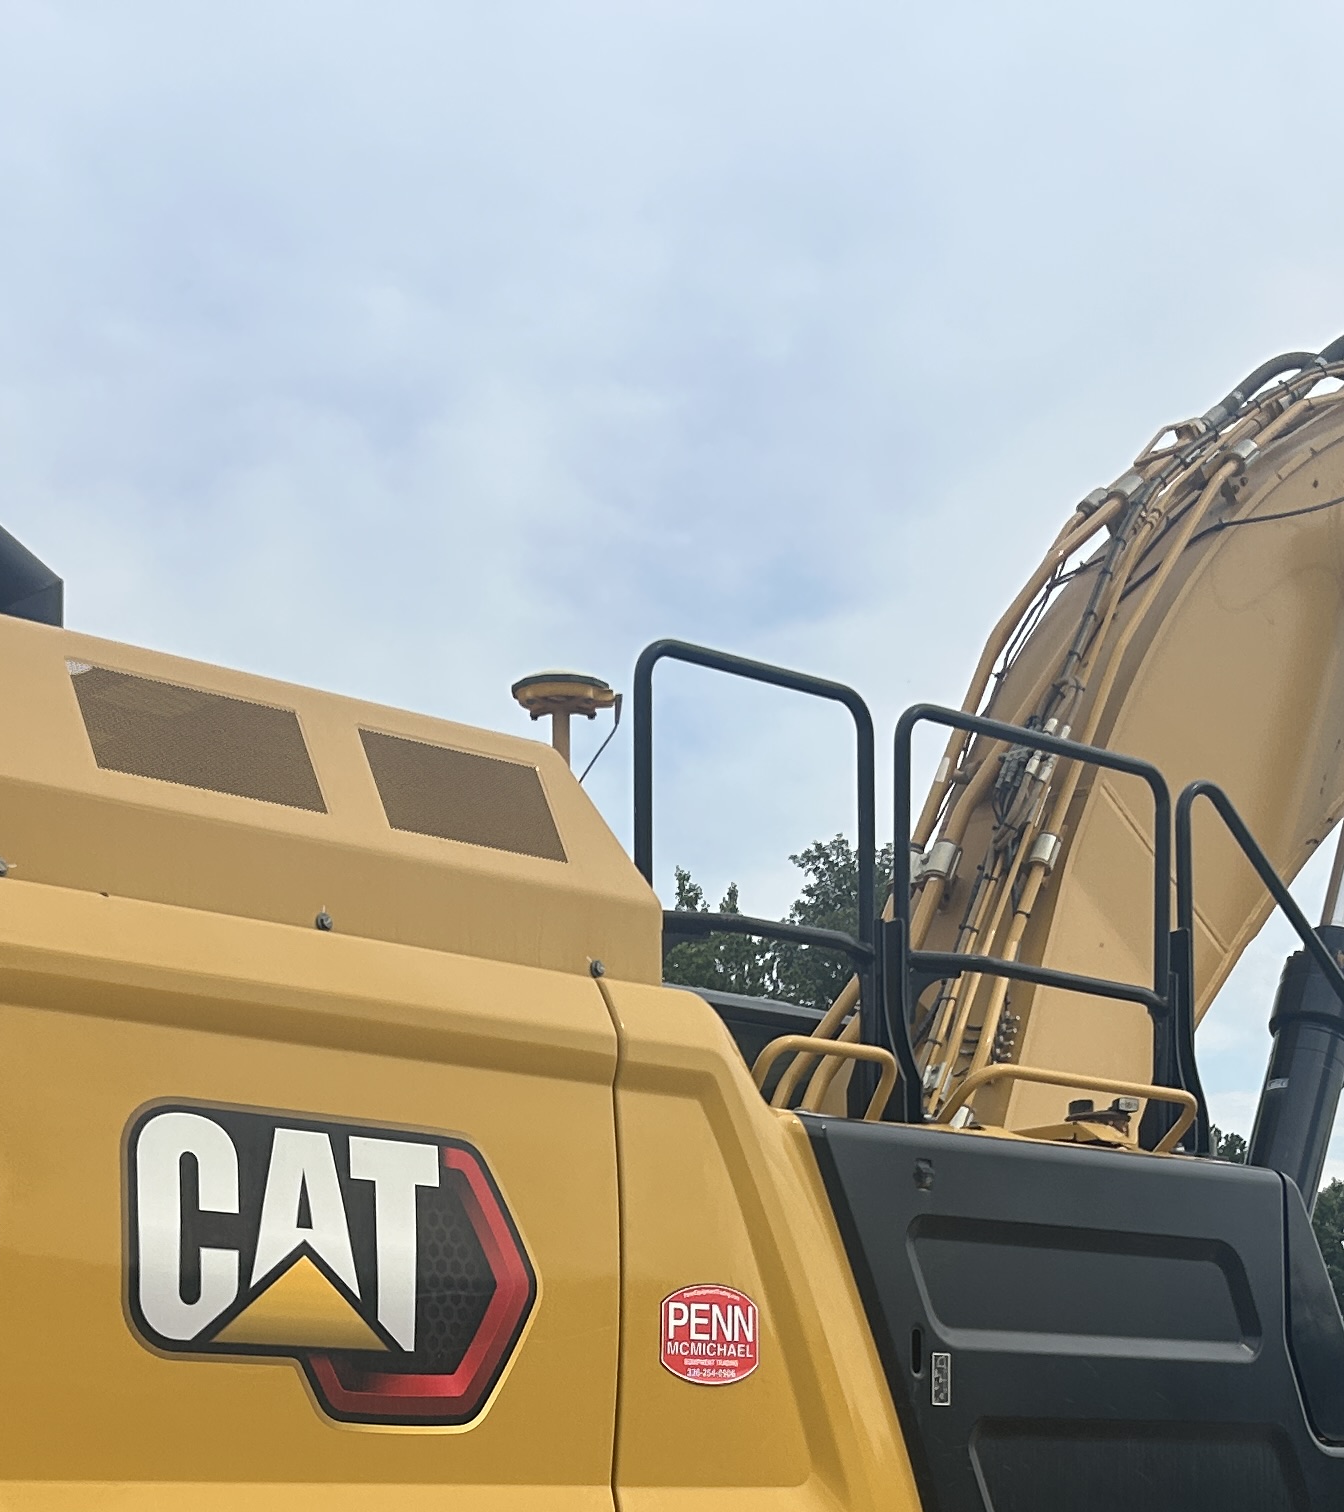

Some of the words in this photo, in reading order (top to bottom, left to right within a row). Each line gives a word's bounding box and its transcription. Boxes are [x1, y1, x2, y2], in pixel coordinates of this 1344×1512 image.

[136, 1112, 440, 1352] CAT
[668, 1301, 754, 1343] PENN
[666, 1341, 754, 1358] MCMICHAEL
